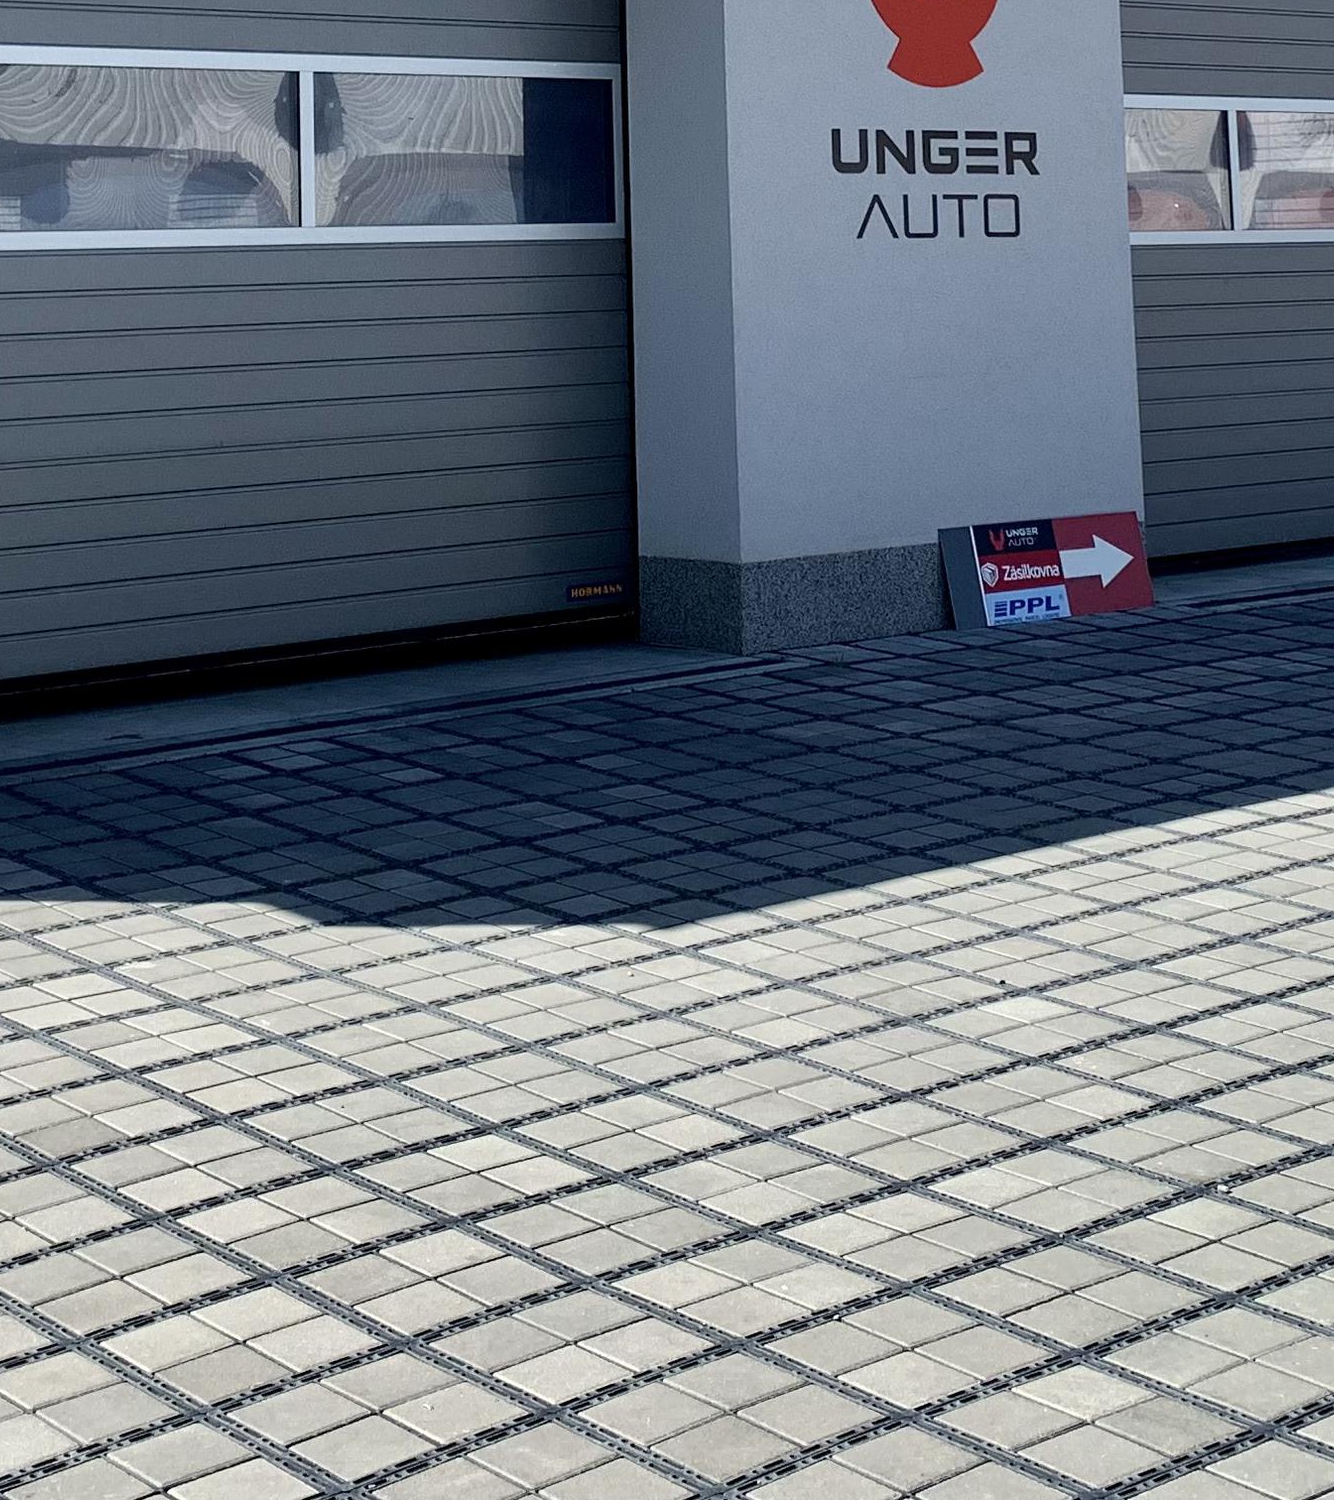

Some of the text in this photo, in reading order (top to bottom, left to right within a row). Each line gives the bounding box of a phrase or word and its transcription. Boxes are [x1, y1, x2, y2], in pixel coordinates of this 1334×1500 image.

[831, 128, 1040, 175] UNGER
[856, 194, 1020, 239] AUTO
[1005, 526, 1039, 537] UNGER
[1008, 536, 1035, 547] AUTO
[1002, 563, 1060, 582] Zásilkovna
